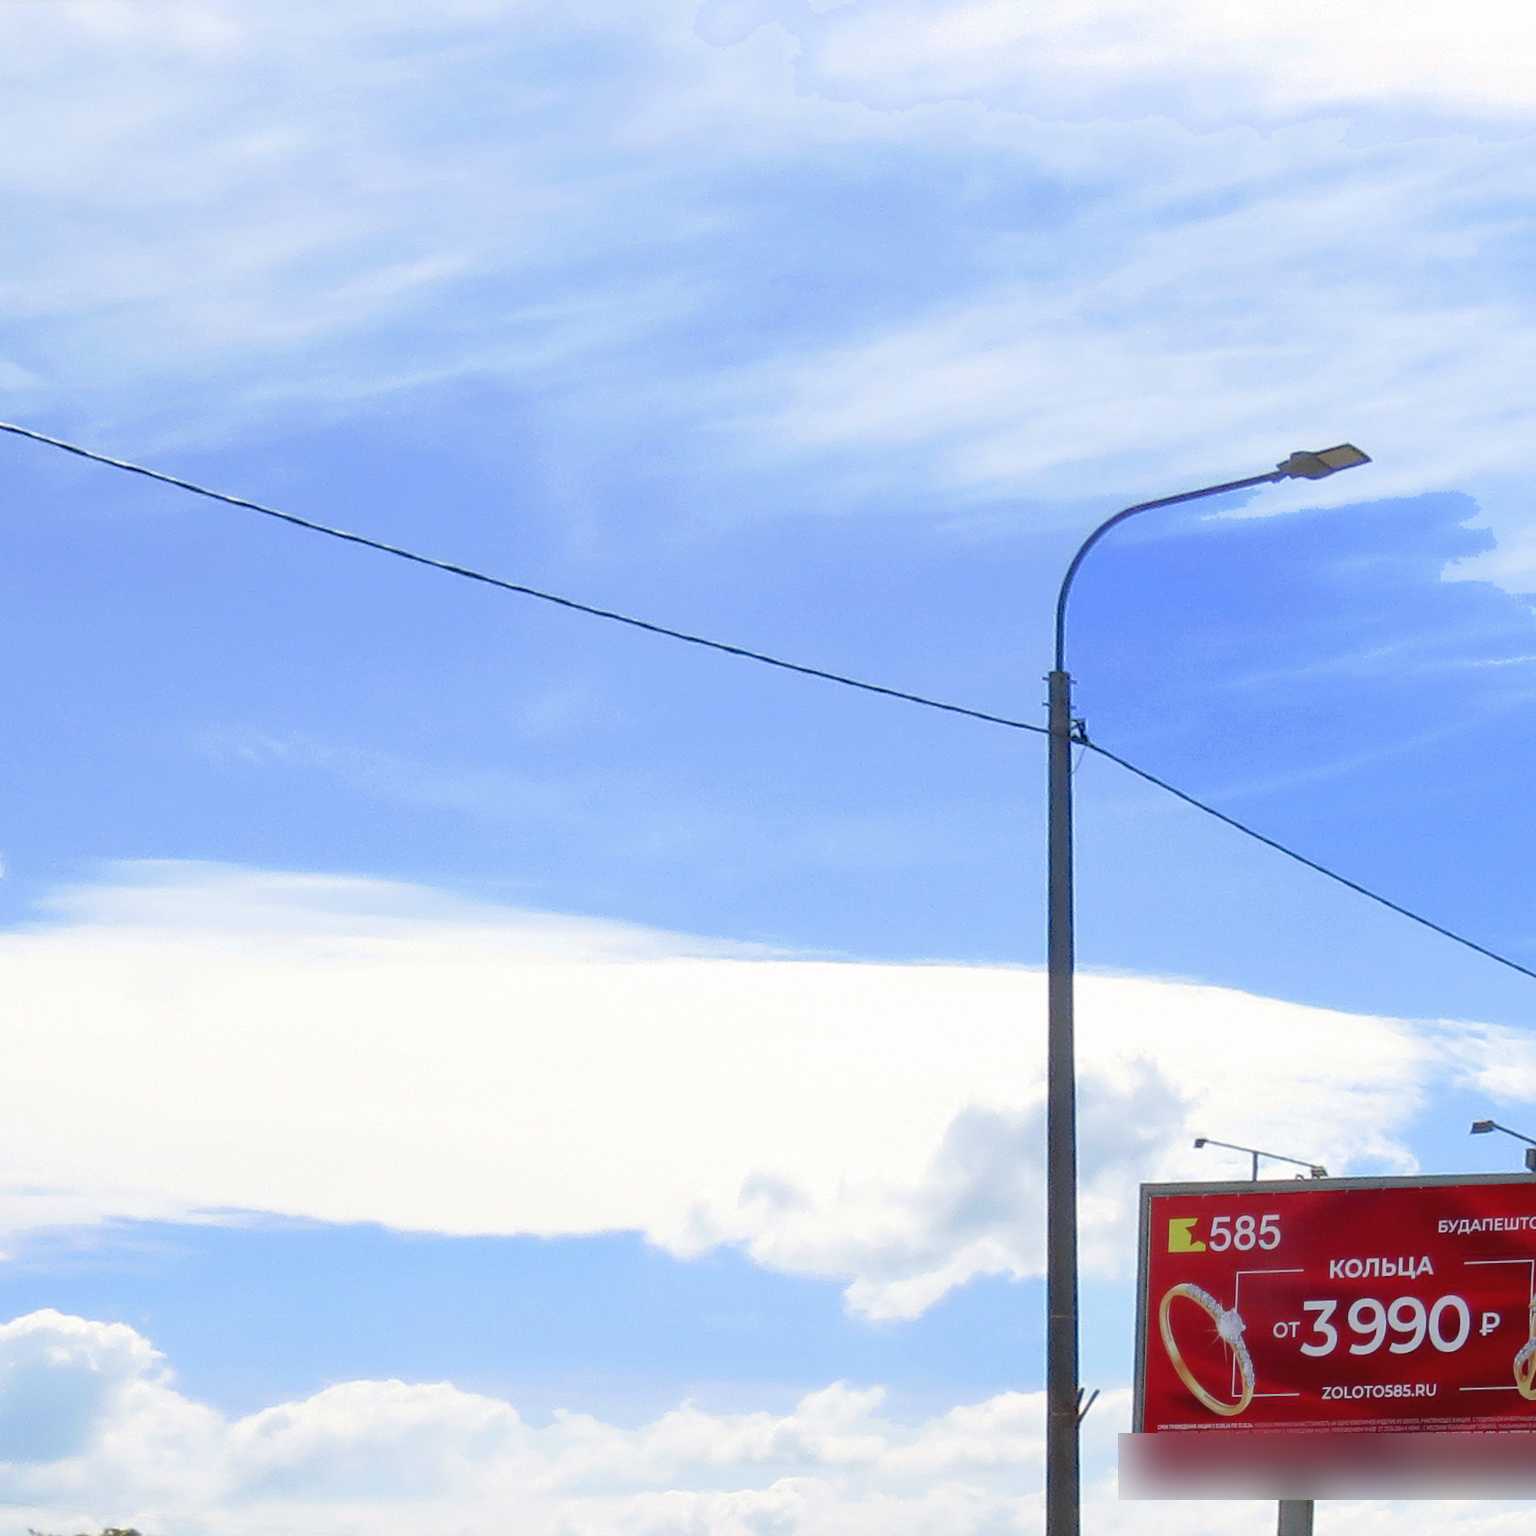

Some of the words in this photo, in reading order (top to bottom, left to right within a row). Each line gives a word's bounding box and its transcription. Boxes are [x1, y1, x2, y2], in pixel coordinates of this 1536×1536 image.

[1208, 1214, 1281, 1252] 585
[1328, 1255, 1435, 1280] КОЛЬЦА
[1321, 1383, 1438, 1401] ZOLOTO585.RU
